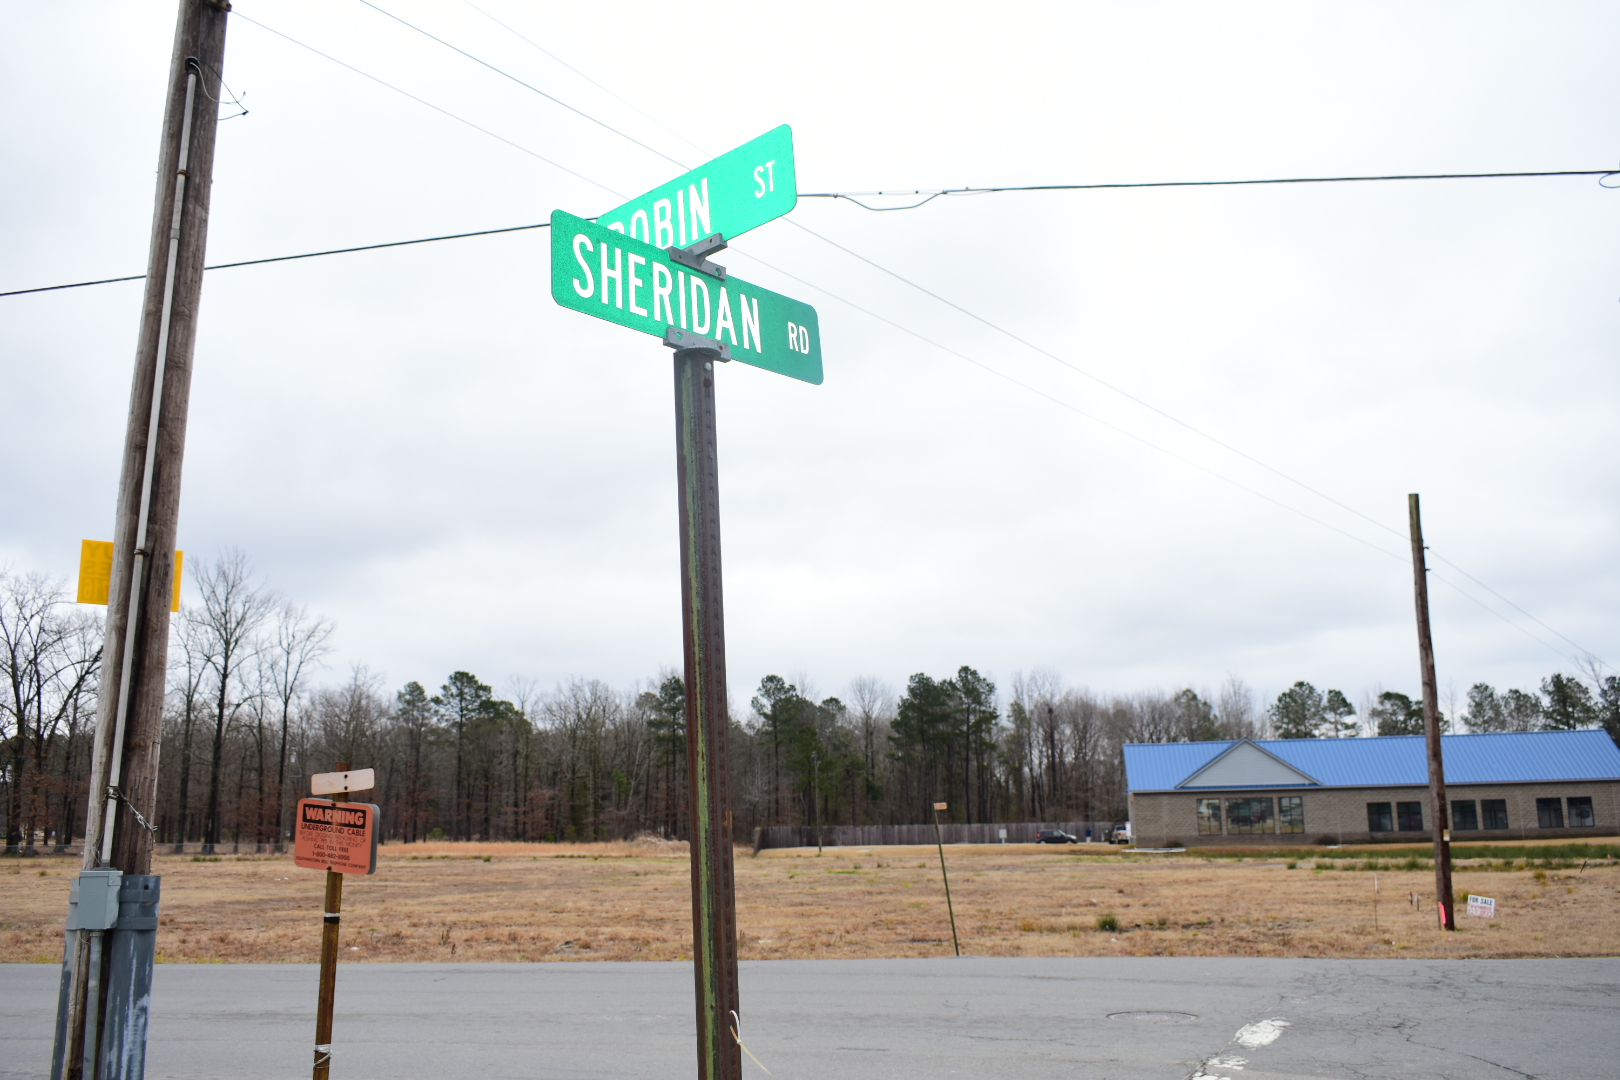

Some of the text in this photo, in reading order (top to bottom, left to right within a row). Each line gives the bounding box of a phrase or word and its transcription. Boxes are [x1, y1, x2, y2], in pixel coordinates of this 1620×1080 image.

[607, 160, 775, 250] OBIN ST
[572, 233, 809, 354] SHERIDAN RD
[305, 806, 364, 825] WARNING
[301, 823, 366, 837] UNDERGROUND CABLE
[1480, 898, 1493, 906] SALE
